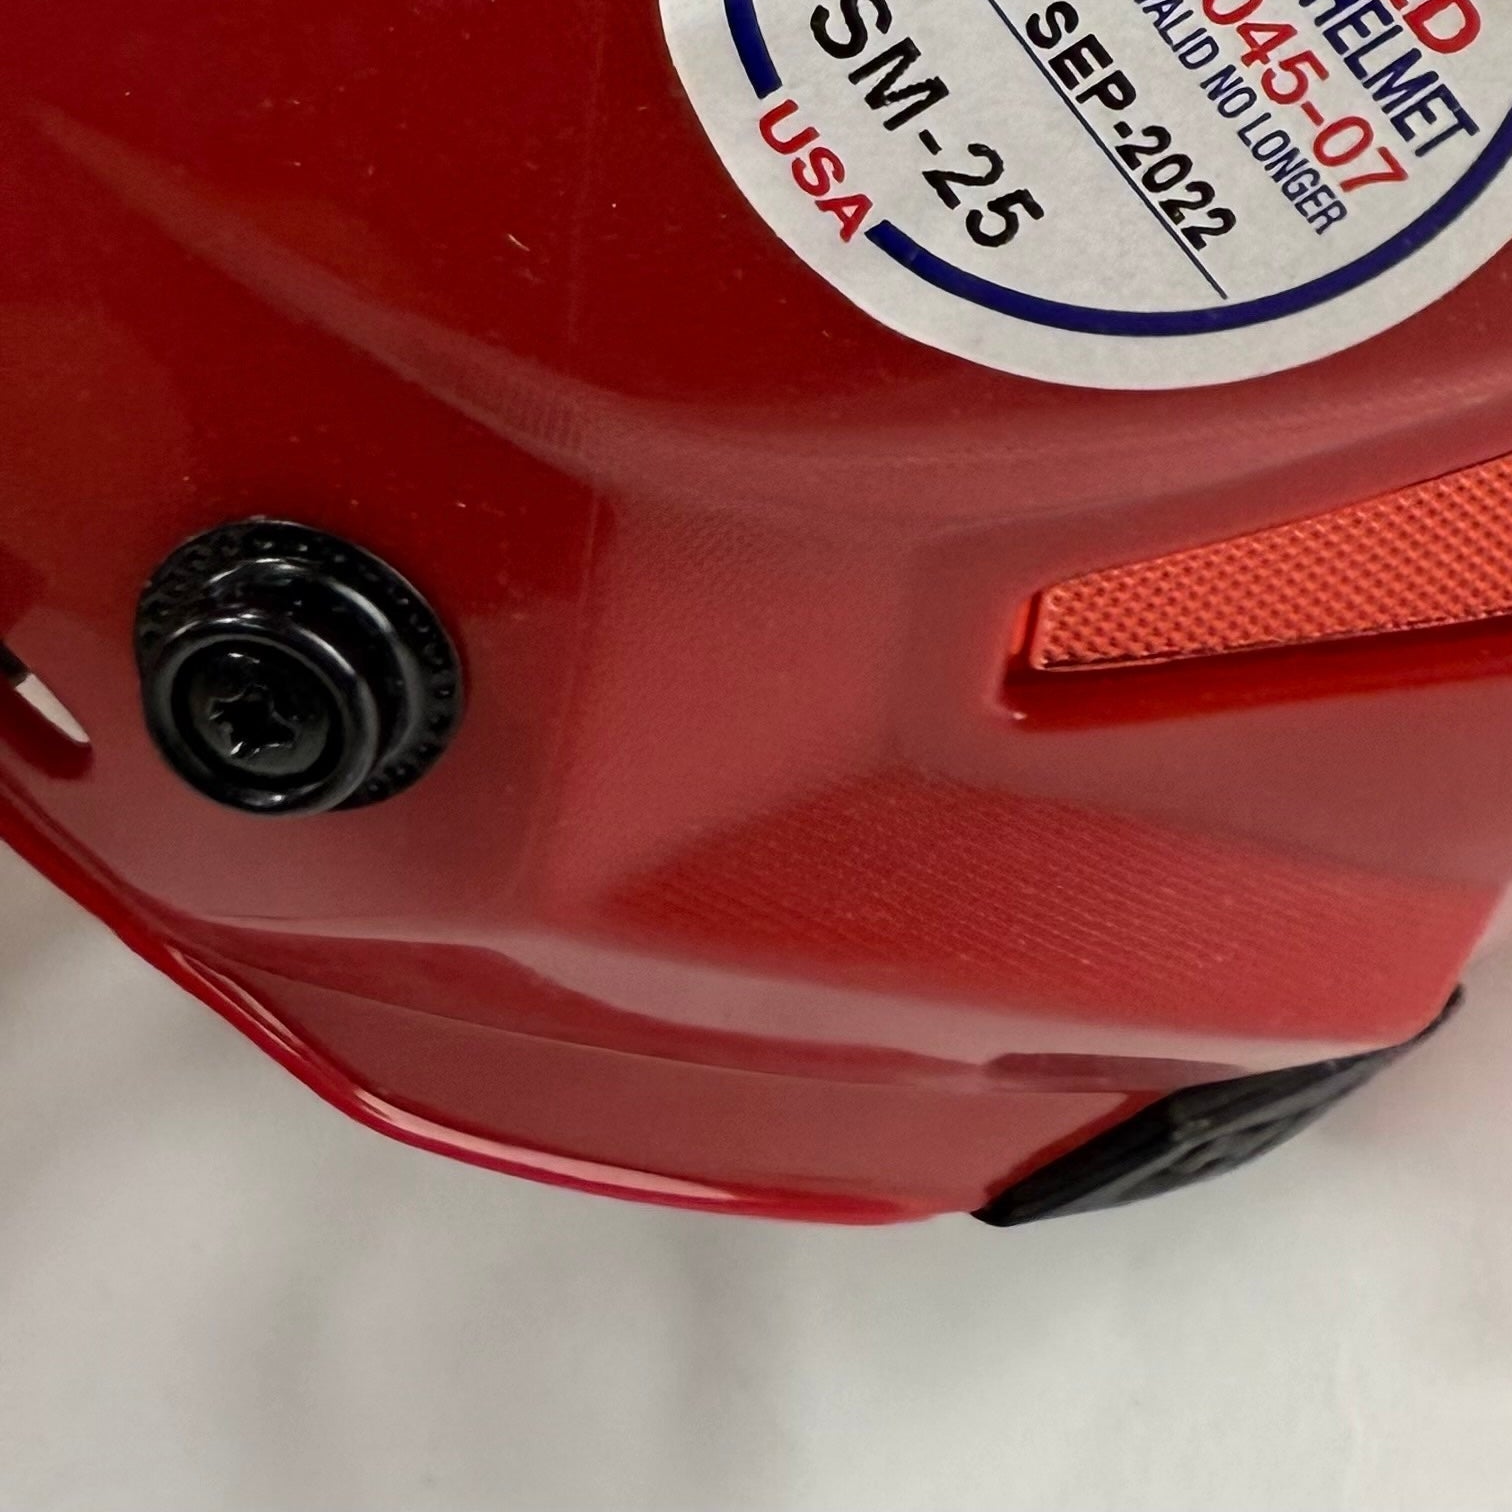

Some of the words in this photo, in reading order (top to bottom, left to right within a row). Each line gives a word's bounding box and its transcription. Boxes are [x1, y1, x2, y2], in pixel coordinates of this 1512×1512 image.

[759, 99, 873, 243] USA
[1026, 1, 1236, 251] SEP-2022
[1200, 65, 1257, 118] NO
[1237, 113, 1347, 235] LONGER
